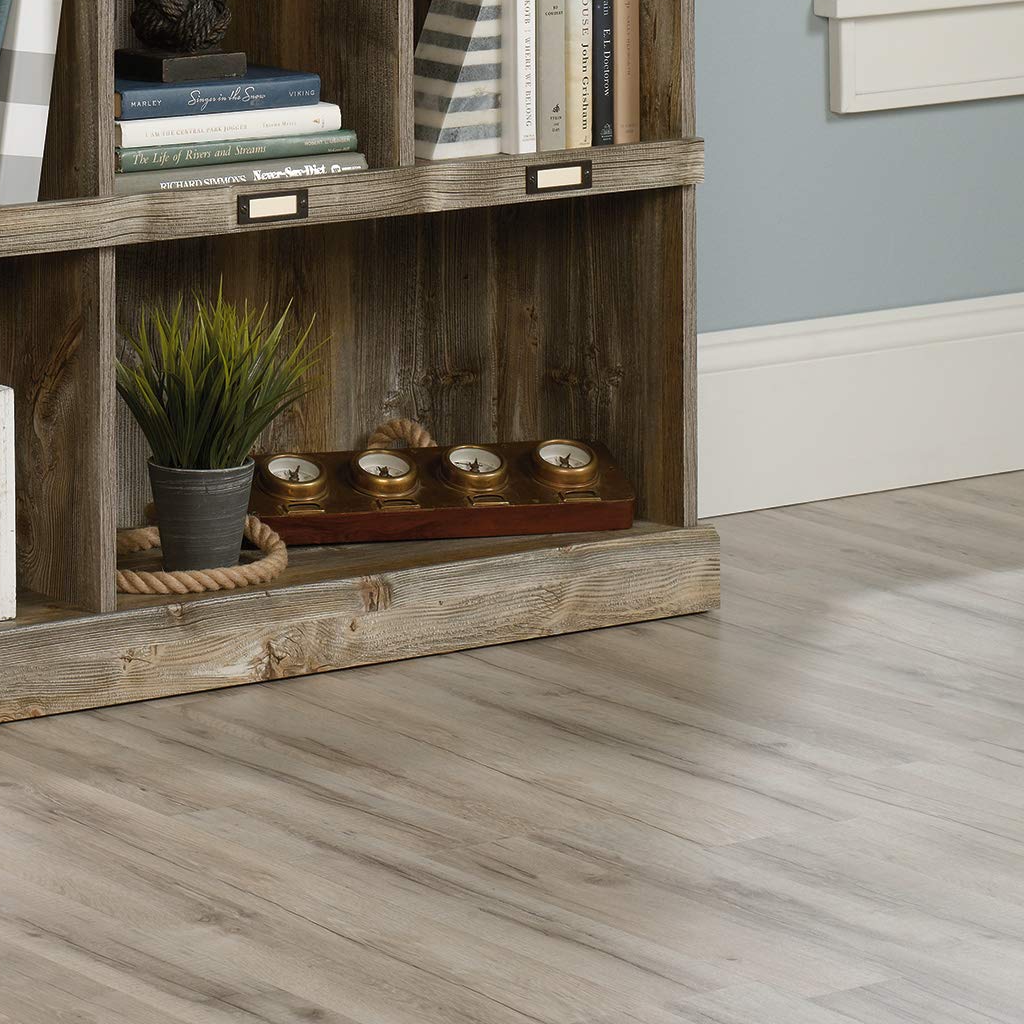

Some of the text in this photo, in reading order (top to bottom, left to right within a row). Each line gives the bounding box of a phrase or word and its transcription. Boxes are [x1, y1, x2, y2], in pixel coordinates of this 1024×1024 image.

[603, 28, 611, 38] E.
[603, 40, 611, 49] L.
[524, 37, 532, 71] WHERE
[581, 43, 589, 73] John
[525, 73, 532, 88] WE
[603, 51, 611, 97] Doctorow
[187, 86, 267, 111] Singer in the Snow
[288, 89, 316, 97] VIKING
[130, 99, 162, 108] MARLEY
[581, 76, 589, 130] Grisham
[132, 145, 267, 166] The Life of Rivers and Streams
[159, 179, 203, 190] RICHARD
